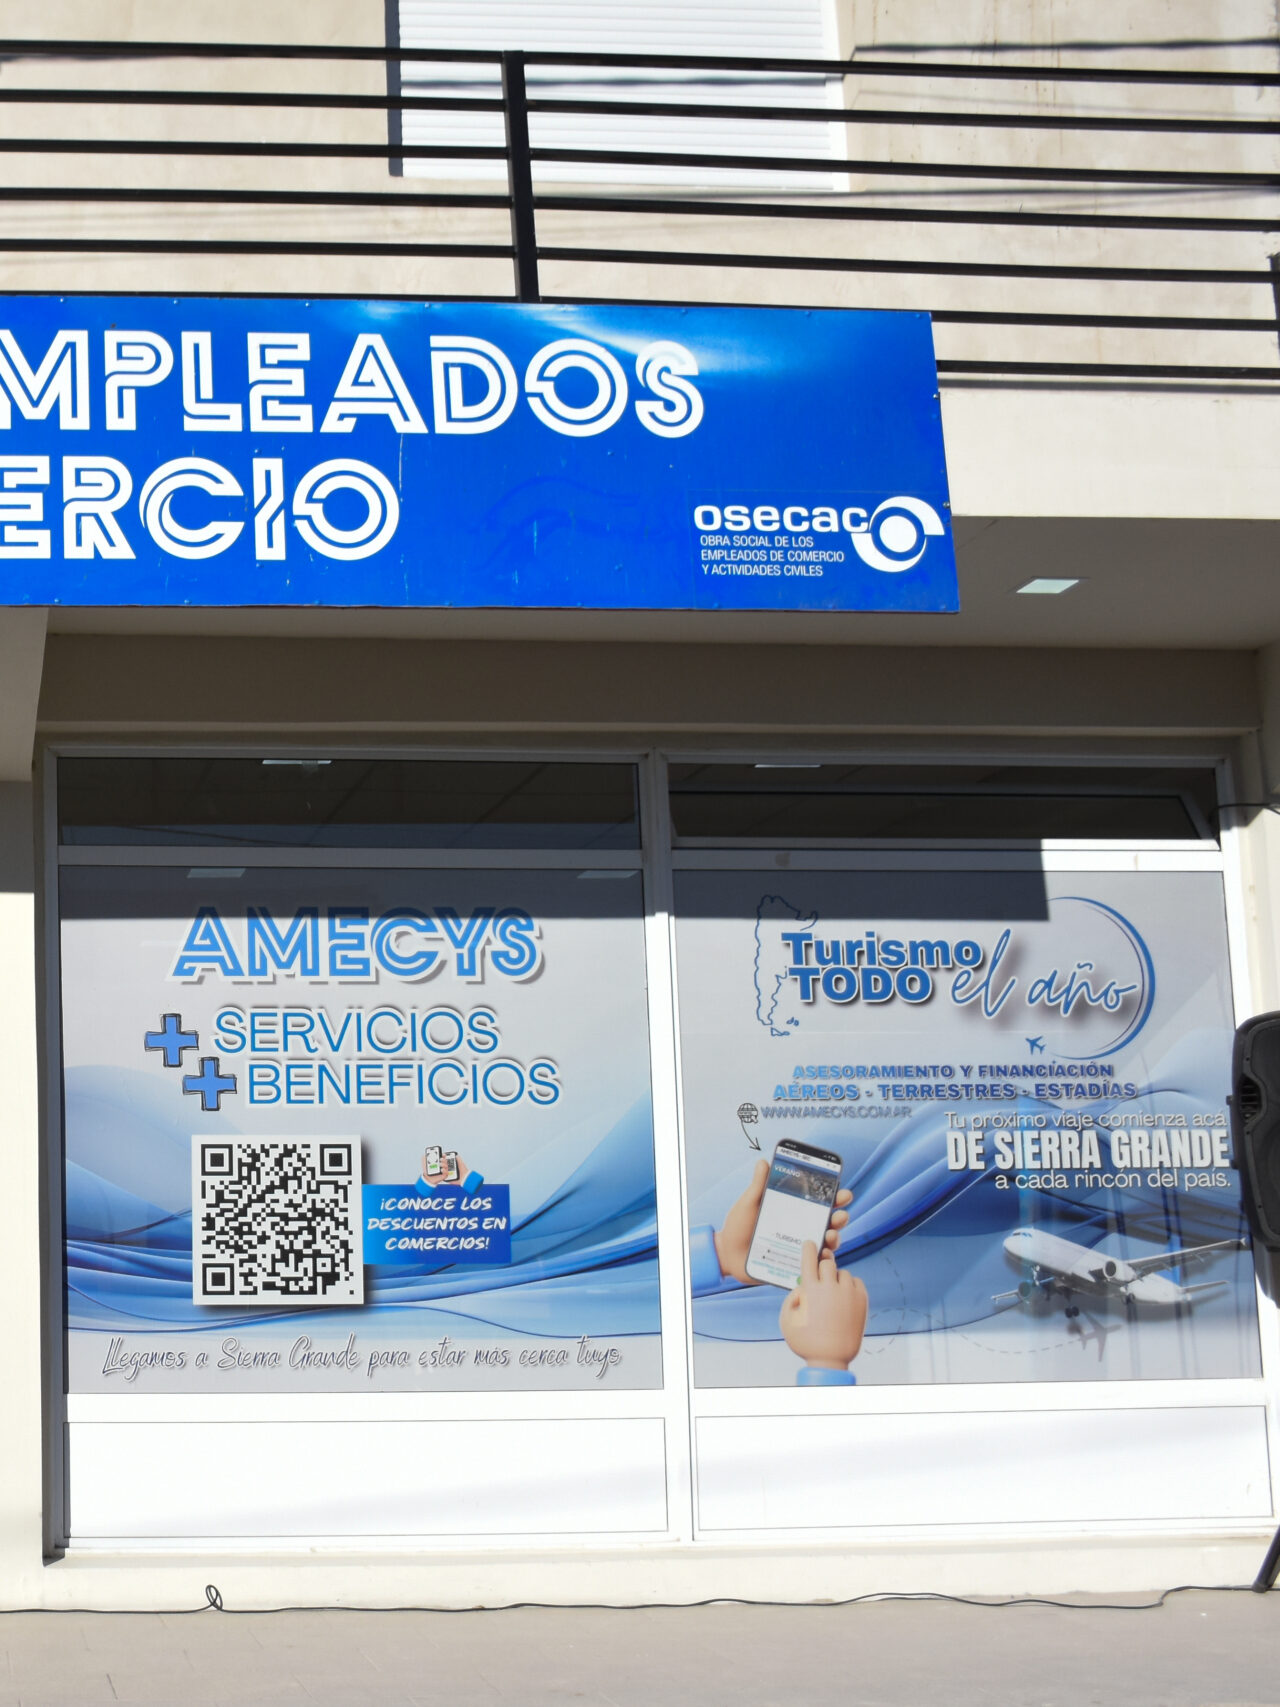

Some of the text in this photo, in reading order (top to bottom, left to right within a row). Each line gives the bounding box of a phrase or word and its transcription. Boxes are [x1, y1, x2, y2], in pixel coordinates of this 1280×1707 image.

[694, 504, 869, 533] osecac
[700, 535, 814, 548] OBRA SOCIAL DE LOS
[701, 550, 845, 563] EMPLEADOS DE COMERCIO
[702, 565, 823, 577] Y ACTIVIDADES CIVILES
[170, 905, 541, 980] AMECYS
[781, 930, 983, 968] Turismo
[787, 928, 1139, 1018] TODO el año
[214, 1010, 499, 1055] SERVICIOS
[792, 1064, 955, 1079] ASESORAMIENTO
[959, 1065, 972, 1078] Y
[248, 1060, 561, 1106] BENEFICIOS
[773, 1081, 860, 1100] AÉREOS
[878, 1083, 1017, 1100] TERRESTRES
[1034, 1080, 1138, 1099] ESTADÍAS
[944, 1110, 1228, 1132] Tu próximo viaje comienza acá
[946, 1128, 1230, 1171] DE SIERRA GRANDE
[994, 1169, 1232, 1191] a cada rincón del país.
[380, 1196, 493, 1212] ¡CONOCE LOS
[367, 1216, 508, 1231] DESCUENTOS EN
[385, 1236, 490, 1251] COMERCIOS!
[101, 1332, 621, 1381] Llegamos a Sierra Grande para estar más cerca tuyo
